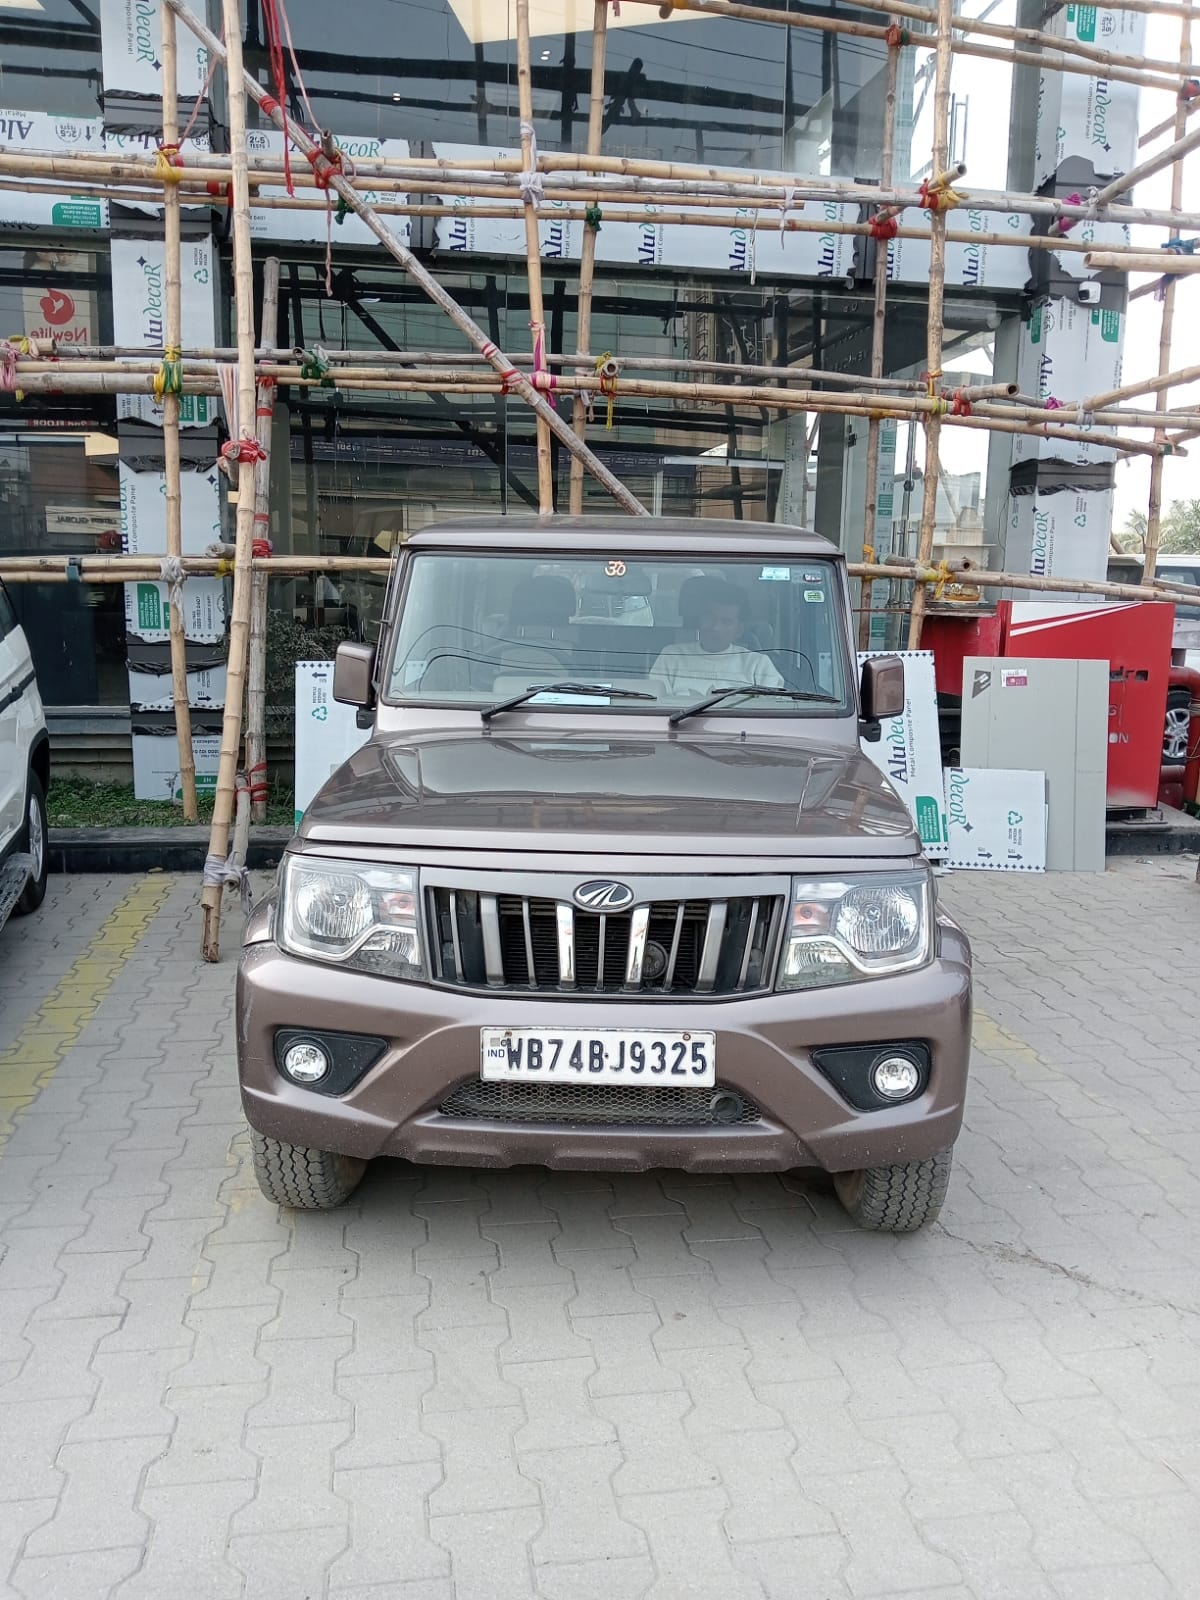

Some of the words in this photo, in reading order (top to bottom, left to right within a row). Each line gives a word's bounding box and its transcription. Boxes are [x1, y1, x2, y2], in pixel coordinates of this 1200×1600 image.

[1091, 79, 1112, 145] udecoR
[129, 484, 137, 504] Panel
[1030, 511, 1049, 576] ludecoR
[487, 1049, 504, 1058] IND
[506, 1038, 707, 1075] WB74BJ9325
